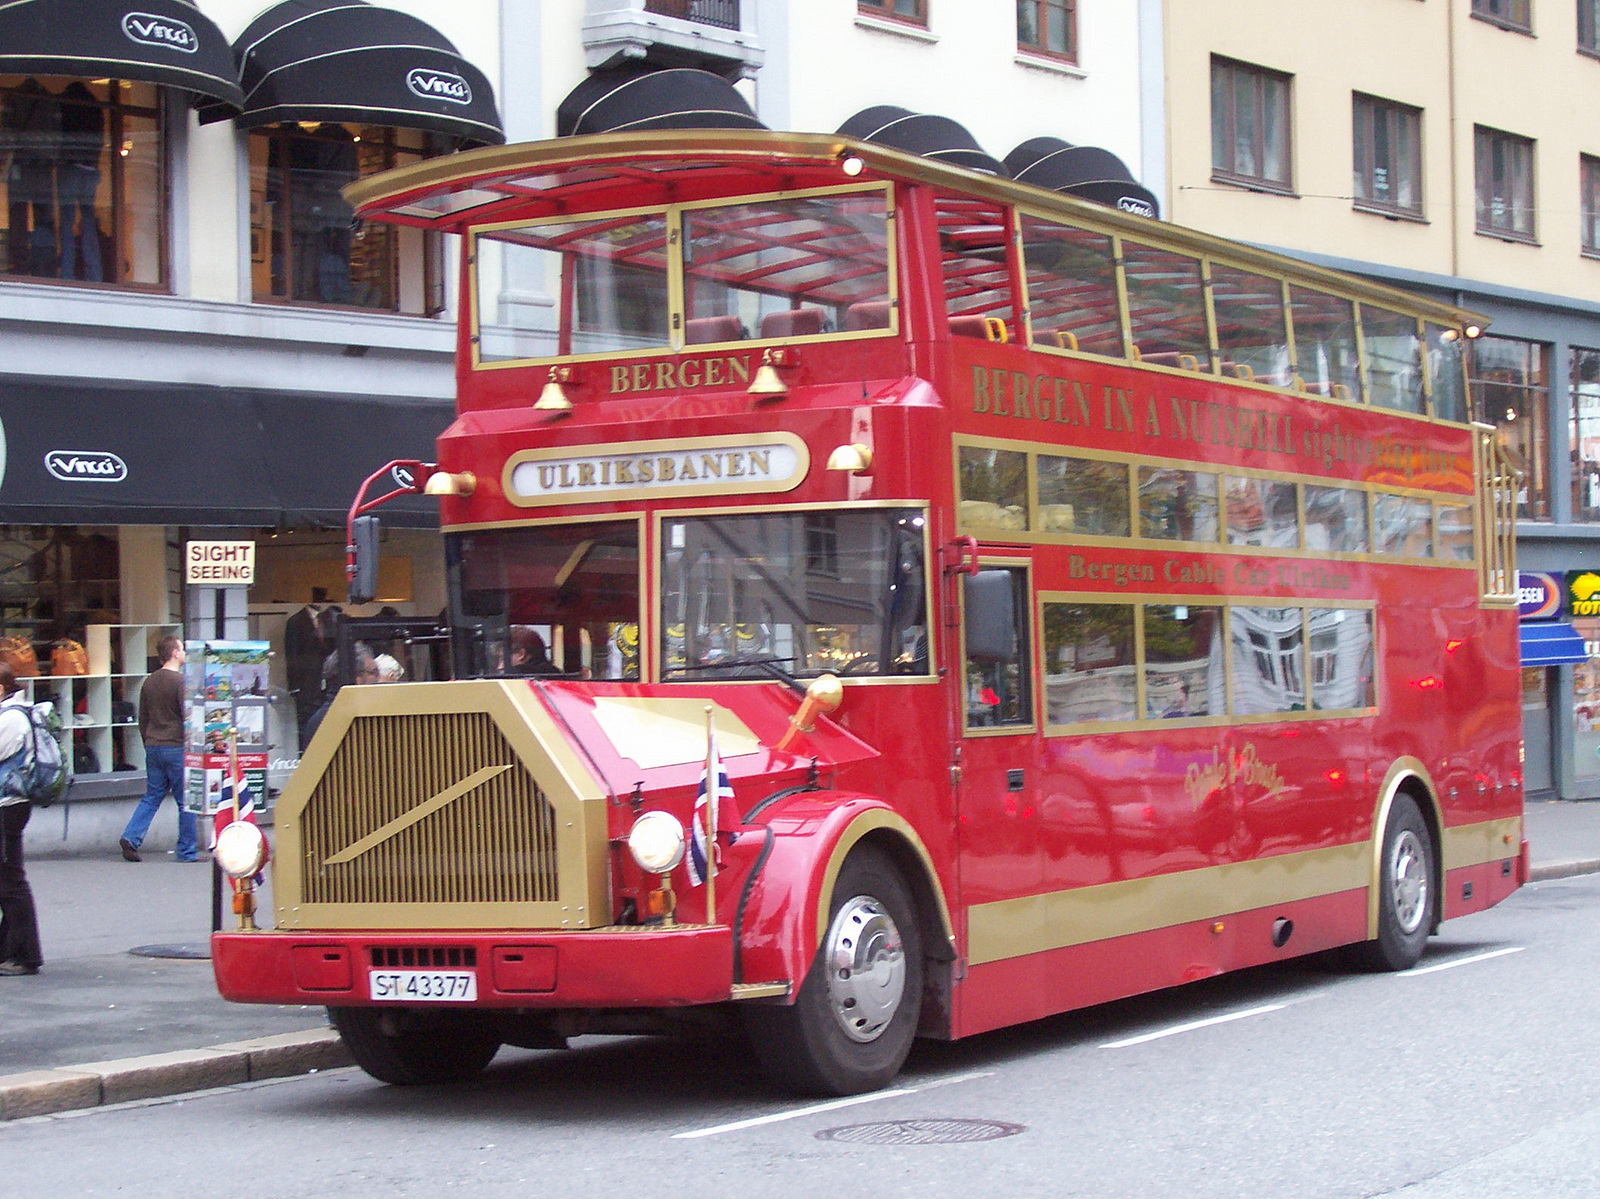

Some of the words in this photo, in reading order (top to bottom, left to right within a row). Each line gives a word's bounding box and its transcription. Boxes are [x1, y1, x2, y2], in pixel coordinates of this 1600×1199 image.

[610, 354, 752, 394] BERGEN
[970, 364, 1092, 427] BERGEN
[1101, 385, 1134, 433] IN
[1145, 393, 1161, 437] A
[1170, 396, 1297, 454] NUTSHELL
[1303, 418, 1414, 482] sightseeing
[537, 449, 771, 490] ULRIKSBANEN
[191, 545, 251, 562] SIGHT
[1067, 553, 1155, 588] Bergen
[1163, 559, 1226, 586] Cable
[1233, 564, 1270, 587] Car
[190, 565, 250, 579] SEEING
[376, 975, 400, 996] ST
[407, 975, 471, 997] 43377
